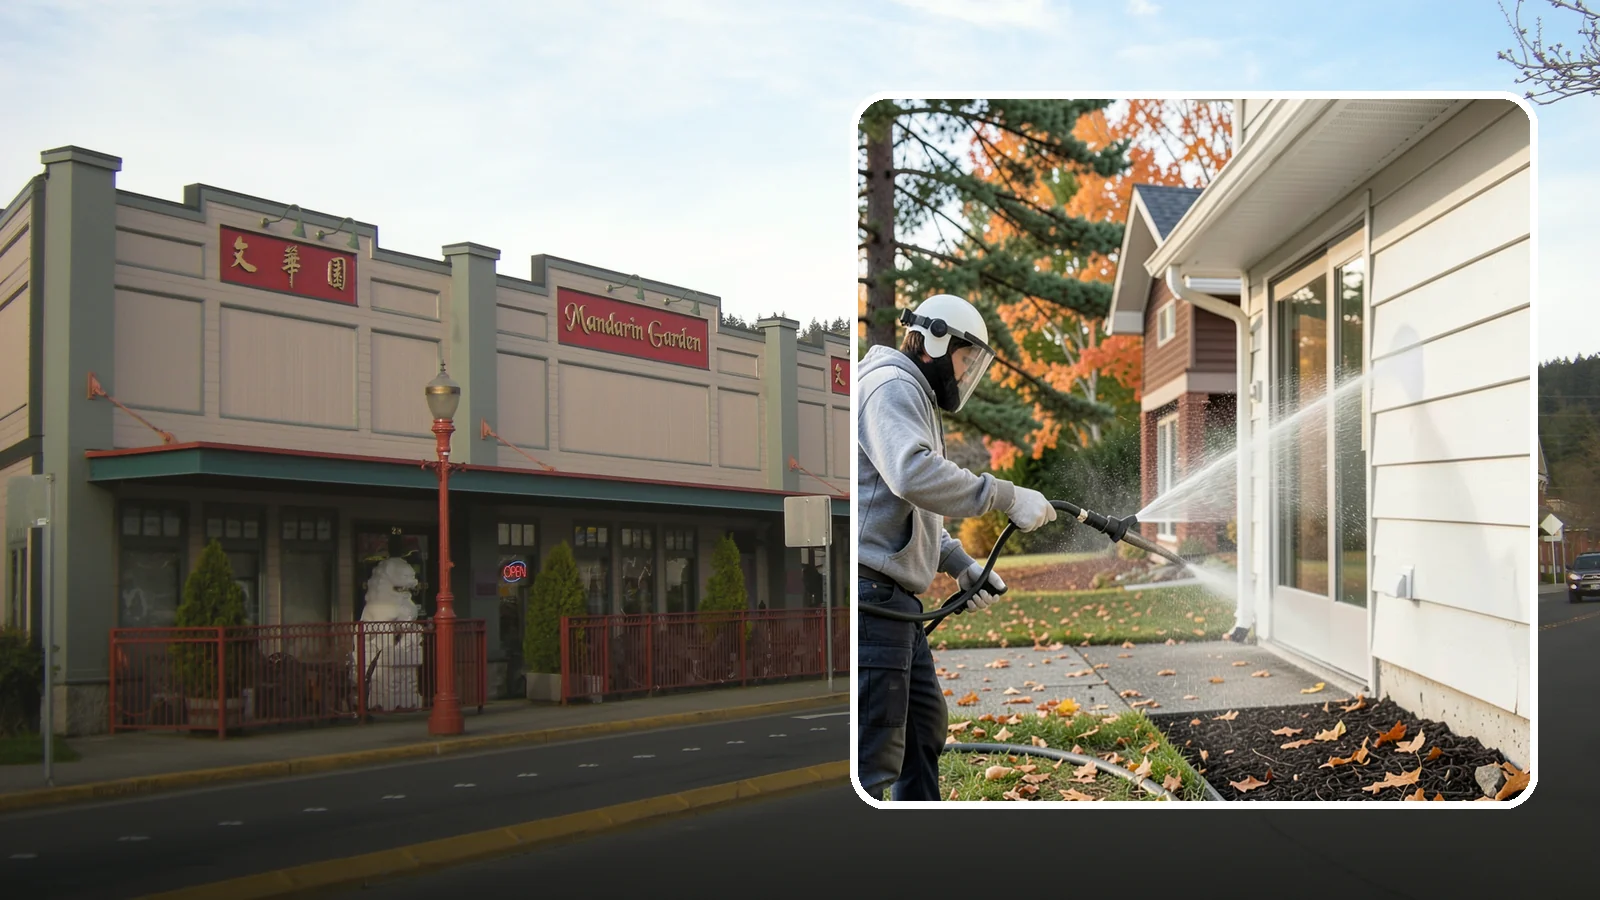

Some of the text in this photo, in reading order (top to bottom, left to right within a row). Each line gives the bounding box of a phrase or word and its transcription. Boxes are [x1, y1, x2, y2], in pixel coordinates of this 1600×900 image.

[231, 235, 346, 290] 文華園
[564, 302, 702, 351] Mandarin Garden
[503, 565, 527, 578] OPEN
